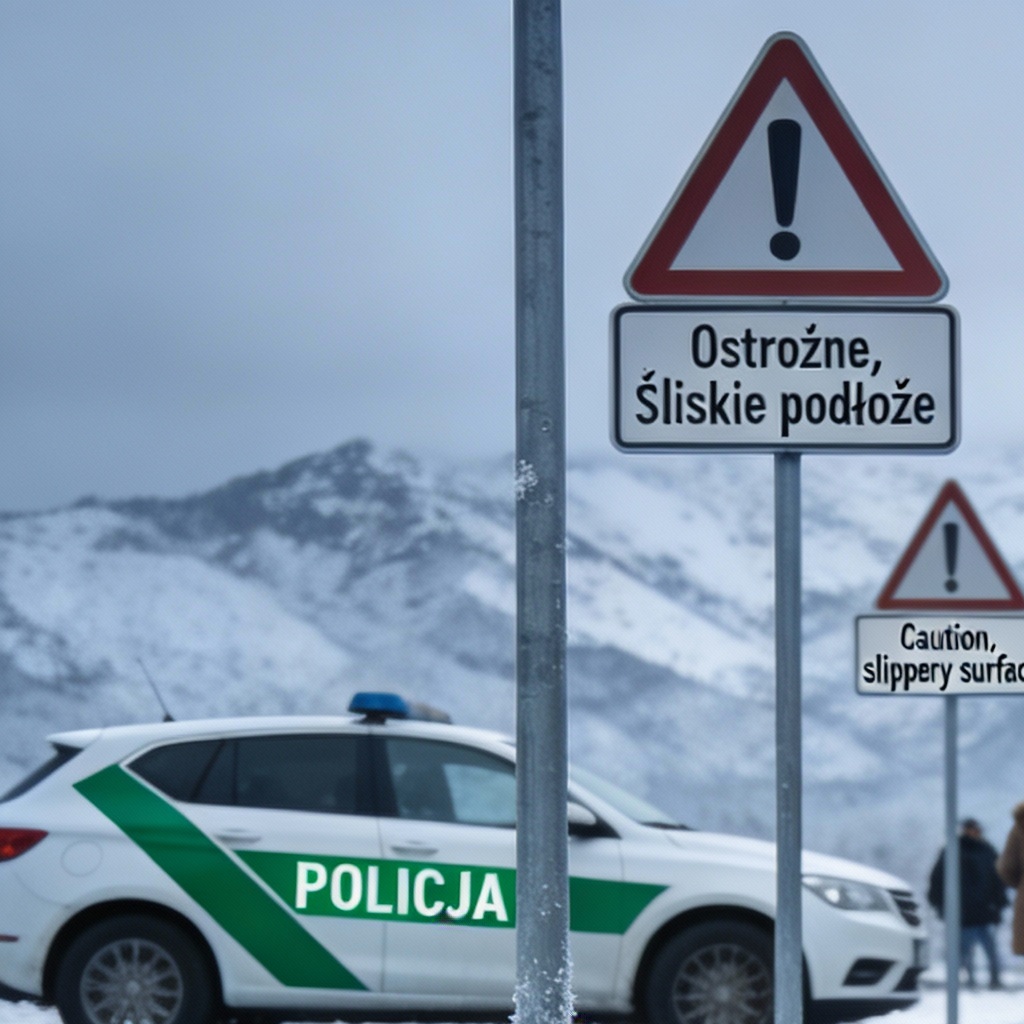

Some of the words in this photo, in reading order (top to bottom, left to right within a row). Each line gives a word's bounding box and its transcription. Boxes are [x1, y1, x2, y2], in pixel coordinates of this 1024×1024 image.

[635, 369, 767, 425] Śliskie
[900, 622, 997, 653] Caution,
[862, 653, 953, 692] slippery
[295, 860, 509, 922] POLICJA
